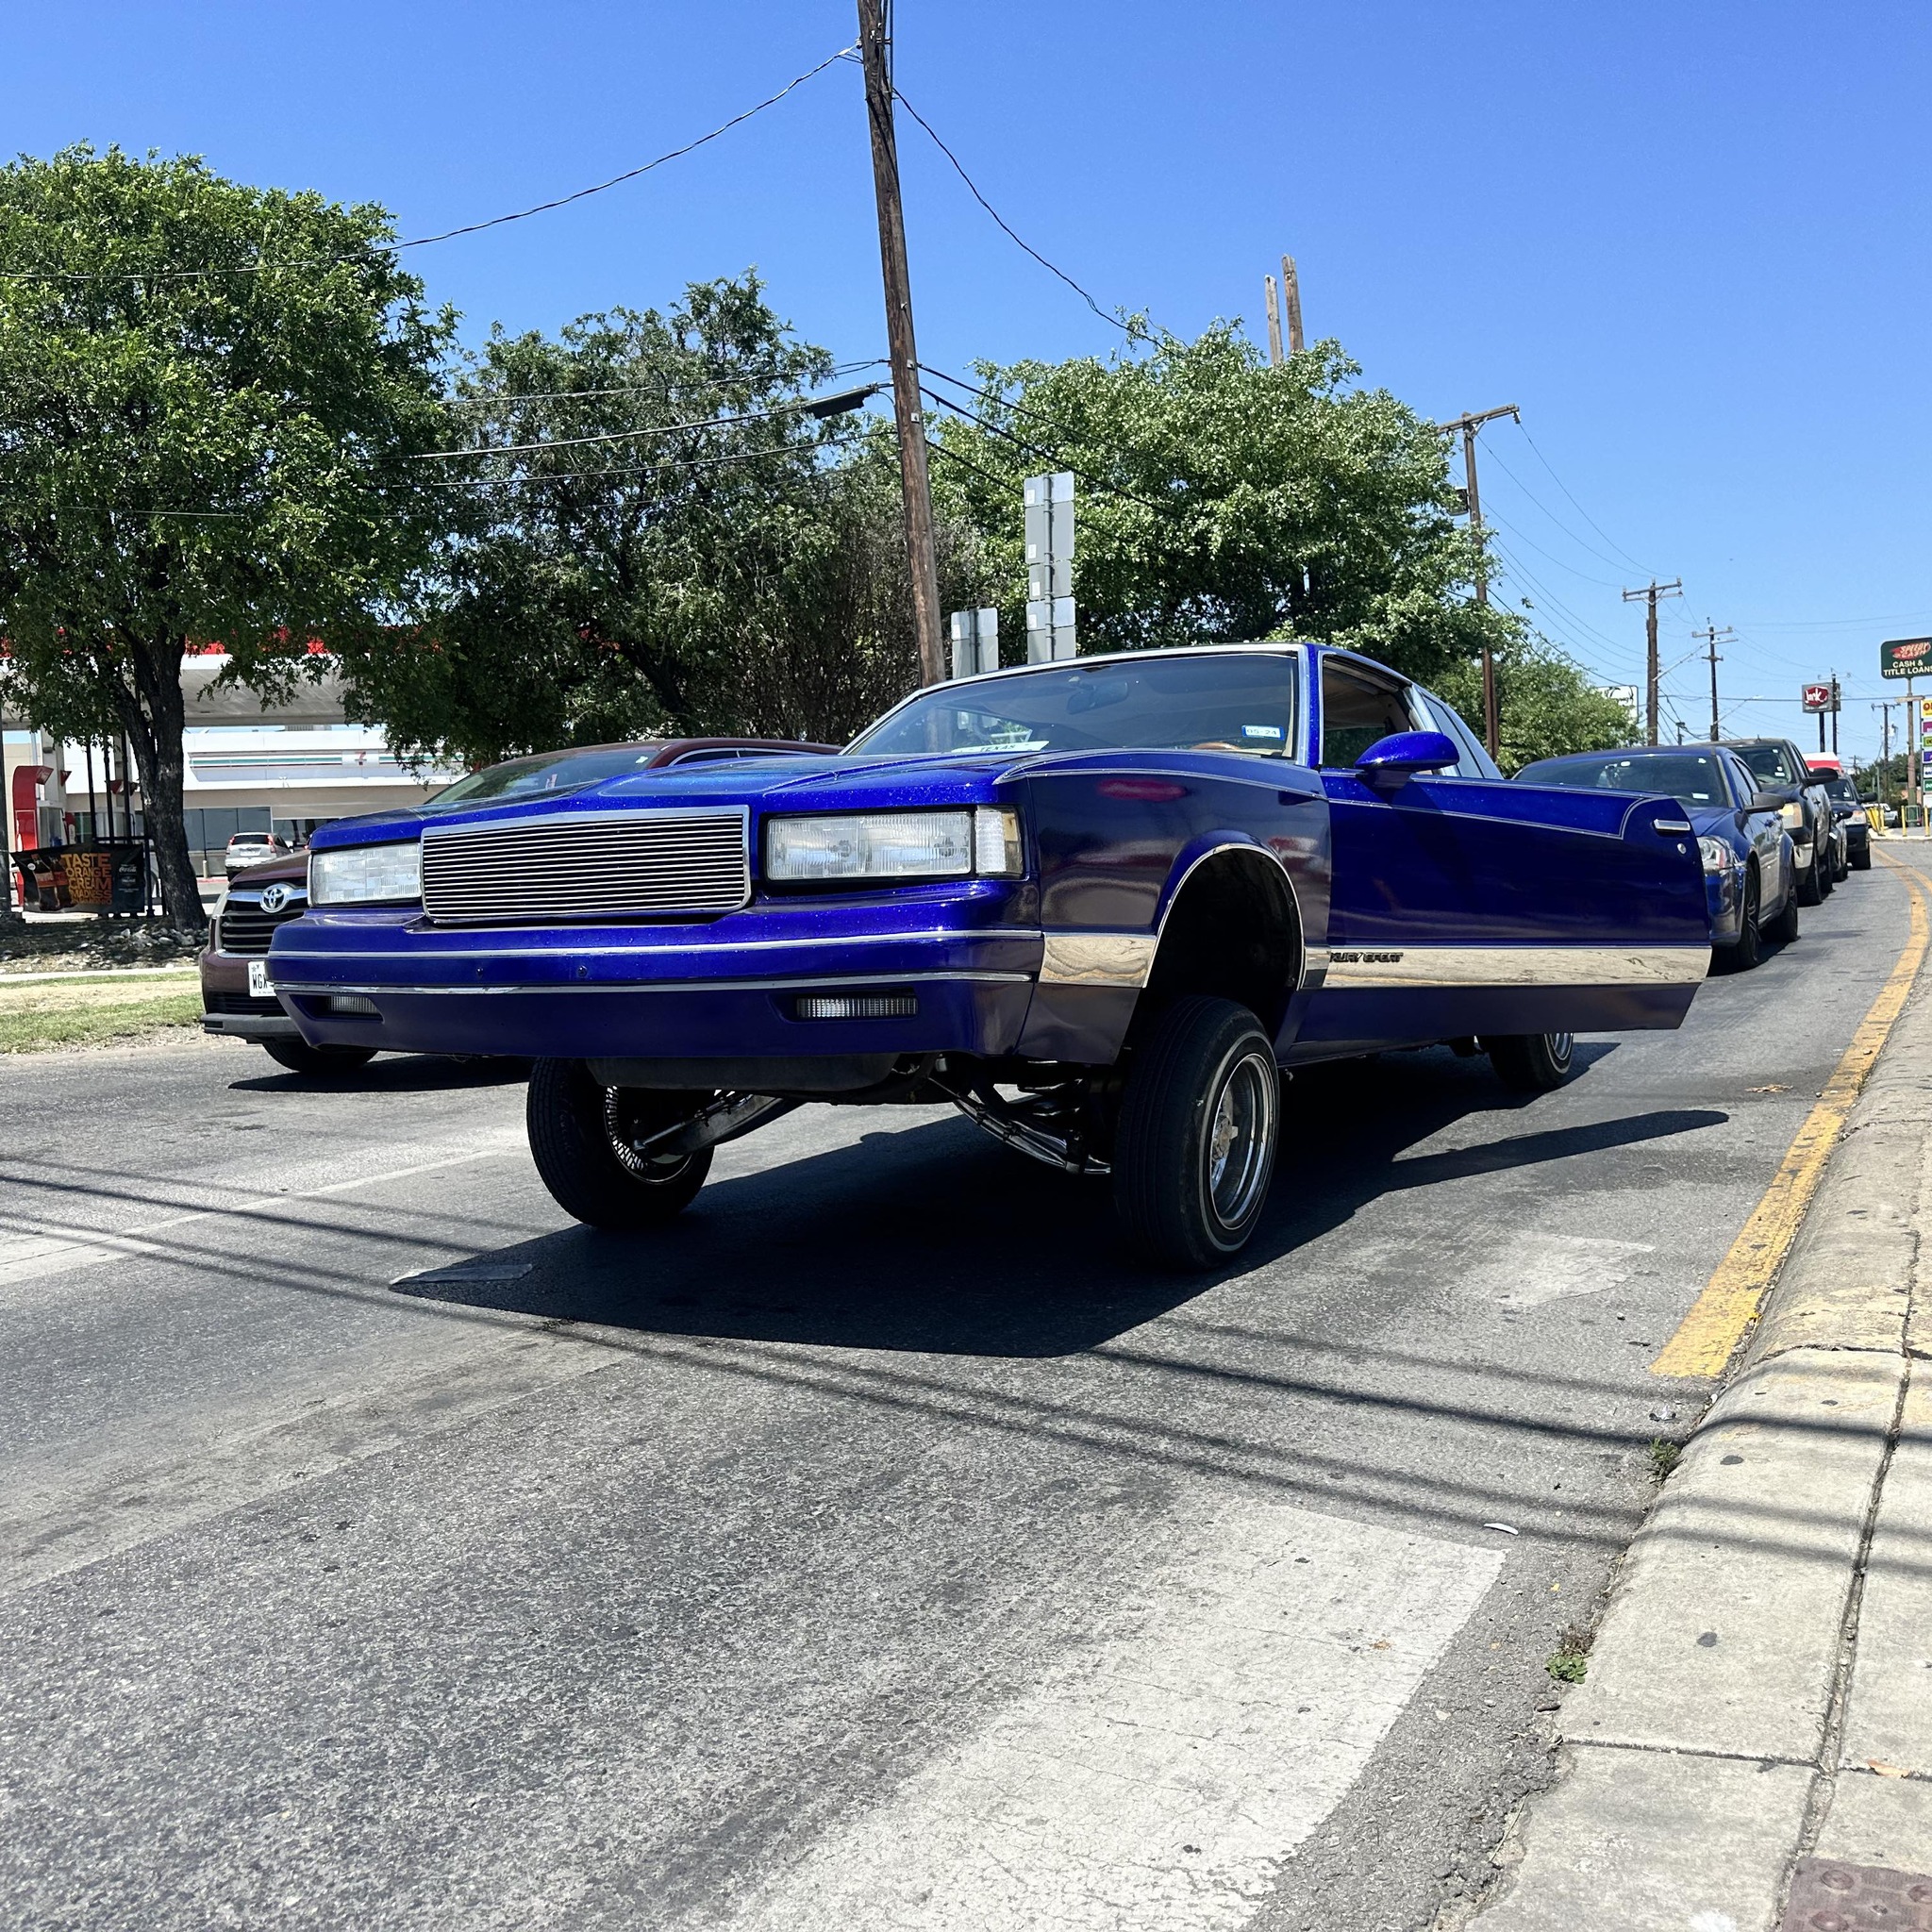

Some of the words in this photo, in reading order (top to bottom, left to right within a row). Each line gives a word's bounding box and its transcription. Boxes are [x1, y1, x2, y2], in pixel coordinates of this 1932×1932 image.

[1884, 668, 1906, 676] TITLE
[60, 853, 111, 868] TASTE
[66, 868, 112, 877] ORANGE
[69, 877, 112, 890] CREAM
[252, 974, 268, 989] WGX
